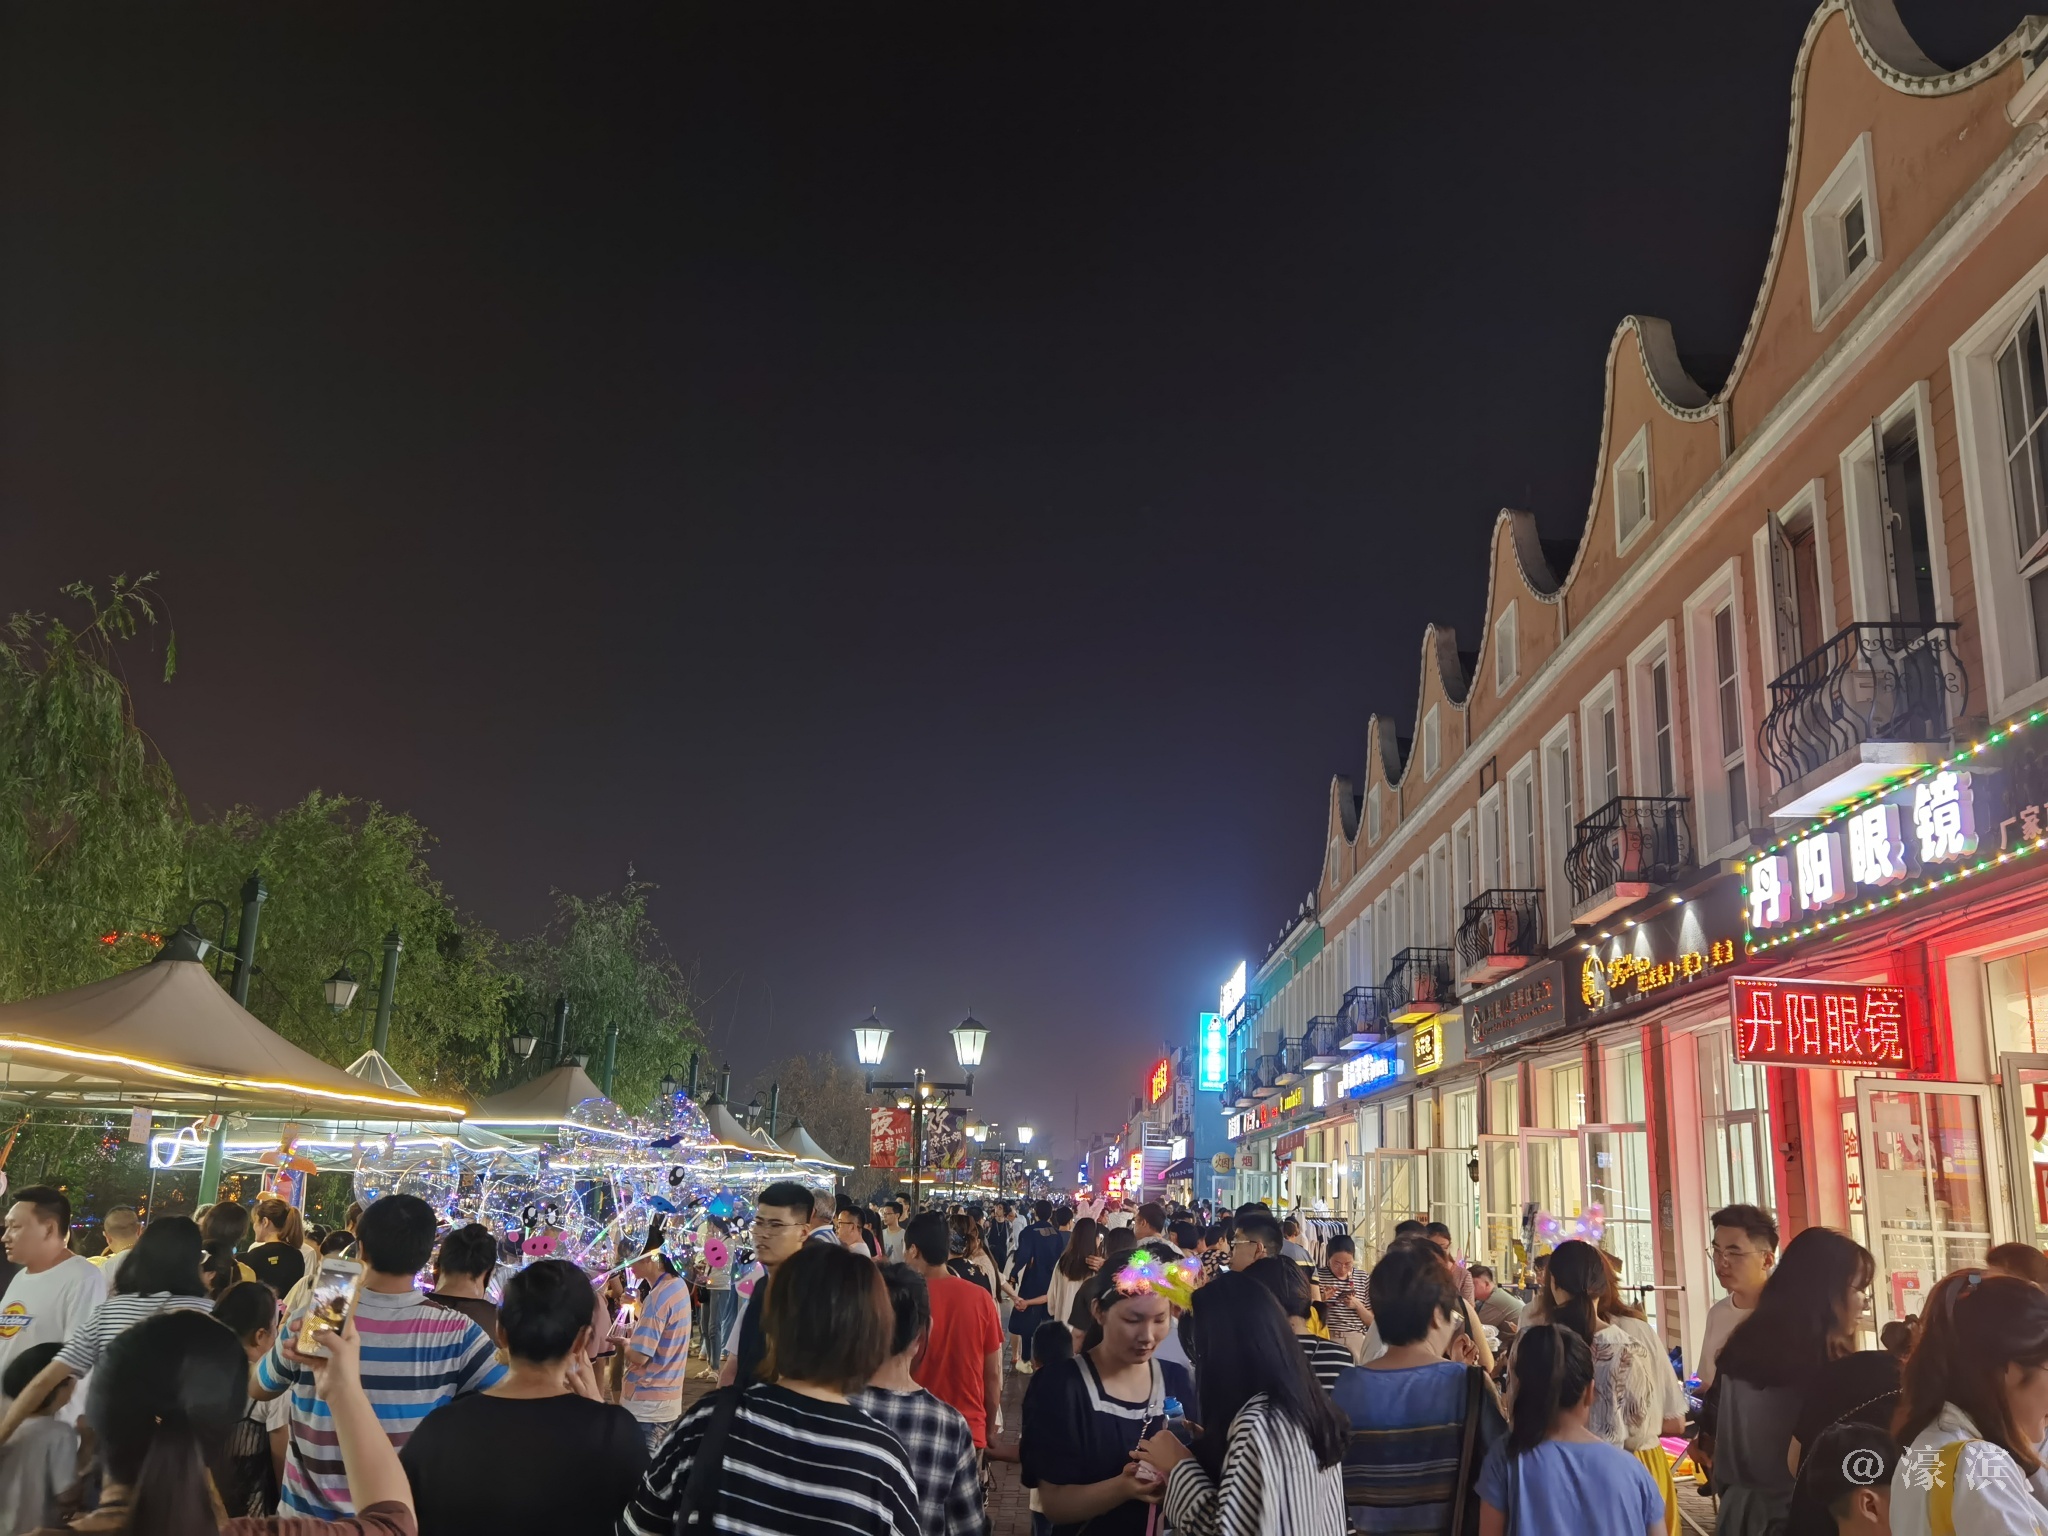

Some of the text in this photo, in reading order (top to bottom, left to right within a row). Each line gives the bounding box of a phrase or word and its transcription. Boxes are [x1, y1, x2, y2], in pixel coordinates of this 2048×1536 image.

[1749, 770, 1976, 928] 丹阳眼镜
[2000, 803, 2048, 850] 厂家
[1744, 991, 1904, 1061] 丹阳眼镜
[871, 1107, 895, 1136] 夜
[1215, 1154, 1230, 1170] 烟
[1242, 1155, 1253, 1167] 烟
[1843, 1128, 1862, 1205] 验光
